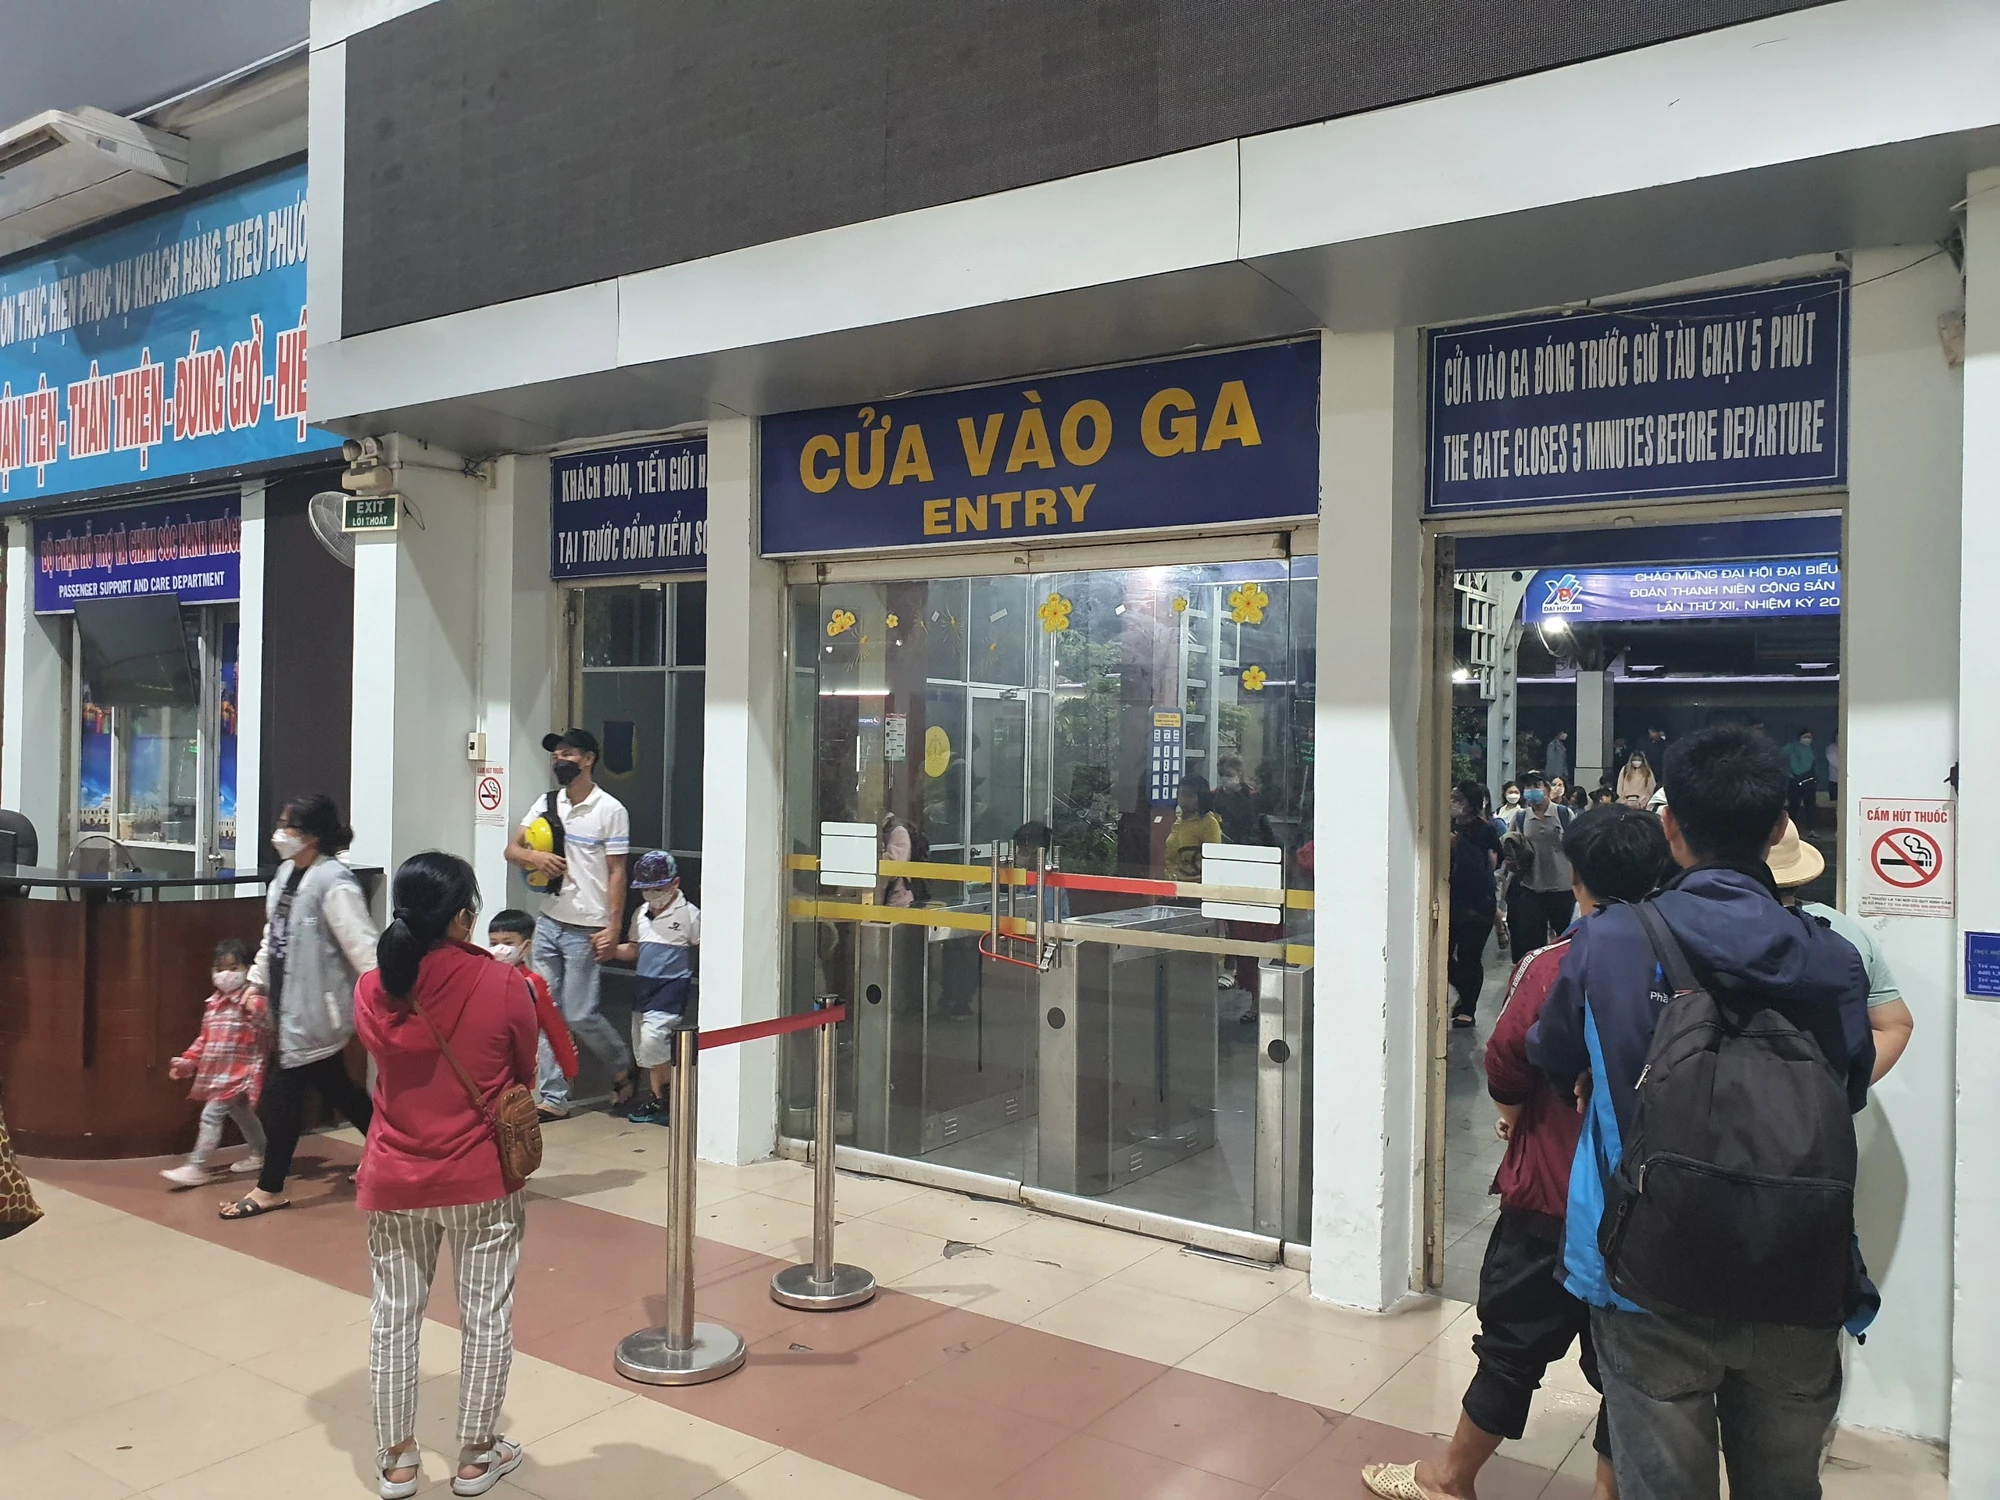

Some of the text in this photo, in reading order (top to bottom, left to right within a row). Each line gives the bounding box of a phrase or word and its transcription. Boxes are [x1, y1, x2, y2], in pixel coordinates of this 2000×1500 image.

[18, 275, 47, 354] THỰC
[49, 268, 78, 346] HIỆN
[79, 264, 112, 336] PHỤC
[115, 258, 131, 330] VỤ
[134, 233, 180, 309] KHÁCH
[182, 220, 221, 296] HÀNG
[225, 213, 264, 283] THEO
[1444, 303, 1816, 406] CỬA VÀO GA ĐÓNG TRƯỚC GIỜ TÀU CHẠY 5 PHÚT
[23, 372, 59, 488] TIỆN
[67, 359, 112, 460] THÂN
[112, 347, 164, 471] THIỆN
[173, 330, 226, 442] ĐÚNG
[227, 314, 264, 432] GIỜ
[800, 379, 1262, 494] CỬA VÀO GA
[1443, 399, 1825, 482] THE GATE CLOSES 5 MINUTES BEFORE DEPARTURE
[562, 461, 600, 503] KHÁCH
[604, 455, 632, 500] ĐÓN,
[637, 449, 666, 494] TIỄN
[356, 501, 385, 514] EXIT
[365, 514, 388, 526] THOÁT
[922, 483, 1097, 536] ENTRY
[41, 532, 54, 578] BỘ
[55, 529, 79, 577] PHẬN
[80, 519, 94, 570] HỖ
[94, 528, 113, 573] TRỢ
[114, 522, 128, 565] VÀ
[129, 522, 156, 565] CHĂM
[158, 516, 178, 561] SÓC
[179, 513, 207, 559] HÀNH
[558, 530, 579, 570] TẠI
[582, 520, 620, 563] TRƯỚC
[622, 512, 655, 561] CỔNG
[657, 509, 692, 557] KIỂM
[58, 570, 225, 598] PASSENGER SUPPORT AND CARE DEPARTMENT
[1630, 579, 1835, 598] ĐOÀN THANH NIÊN CỘNG SẢN
[1634, 571, 1671, 582] CHÀO
[1721, 569, 1744, 580] ĐẠI
[1749, 566, 1772, 578] HỘI
[1776, 566, 1800, 577] ĐẠI
[1688, 600, 1716, 611] THỨ
[1745, 598, 1790, 610] NHIỆM
[1867, 806, 1947, 823] CẤM HÚT THUỐC
